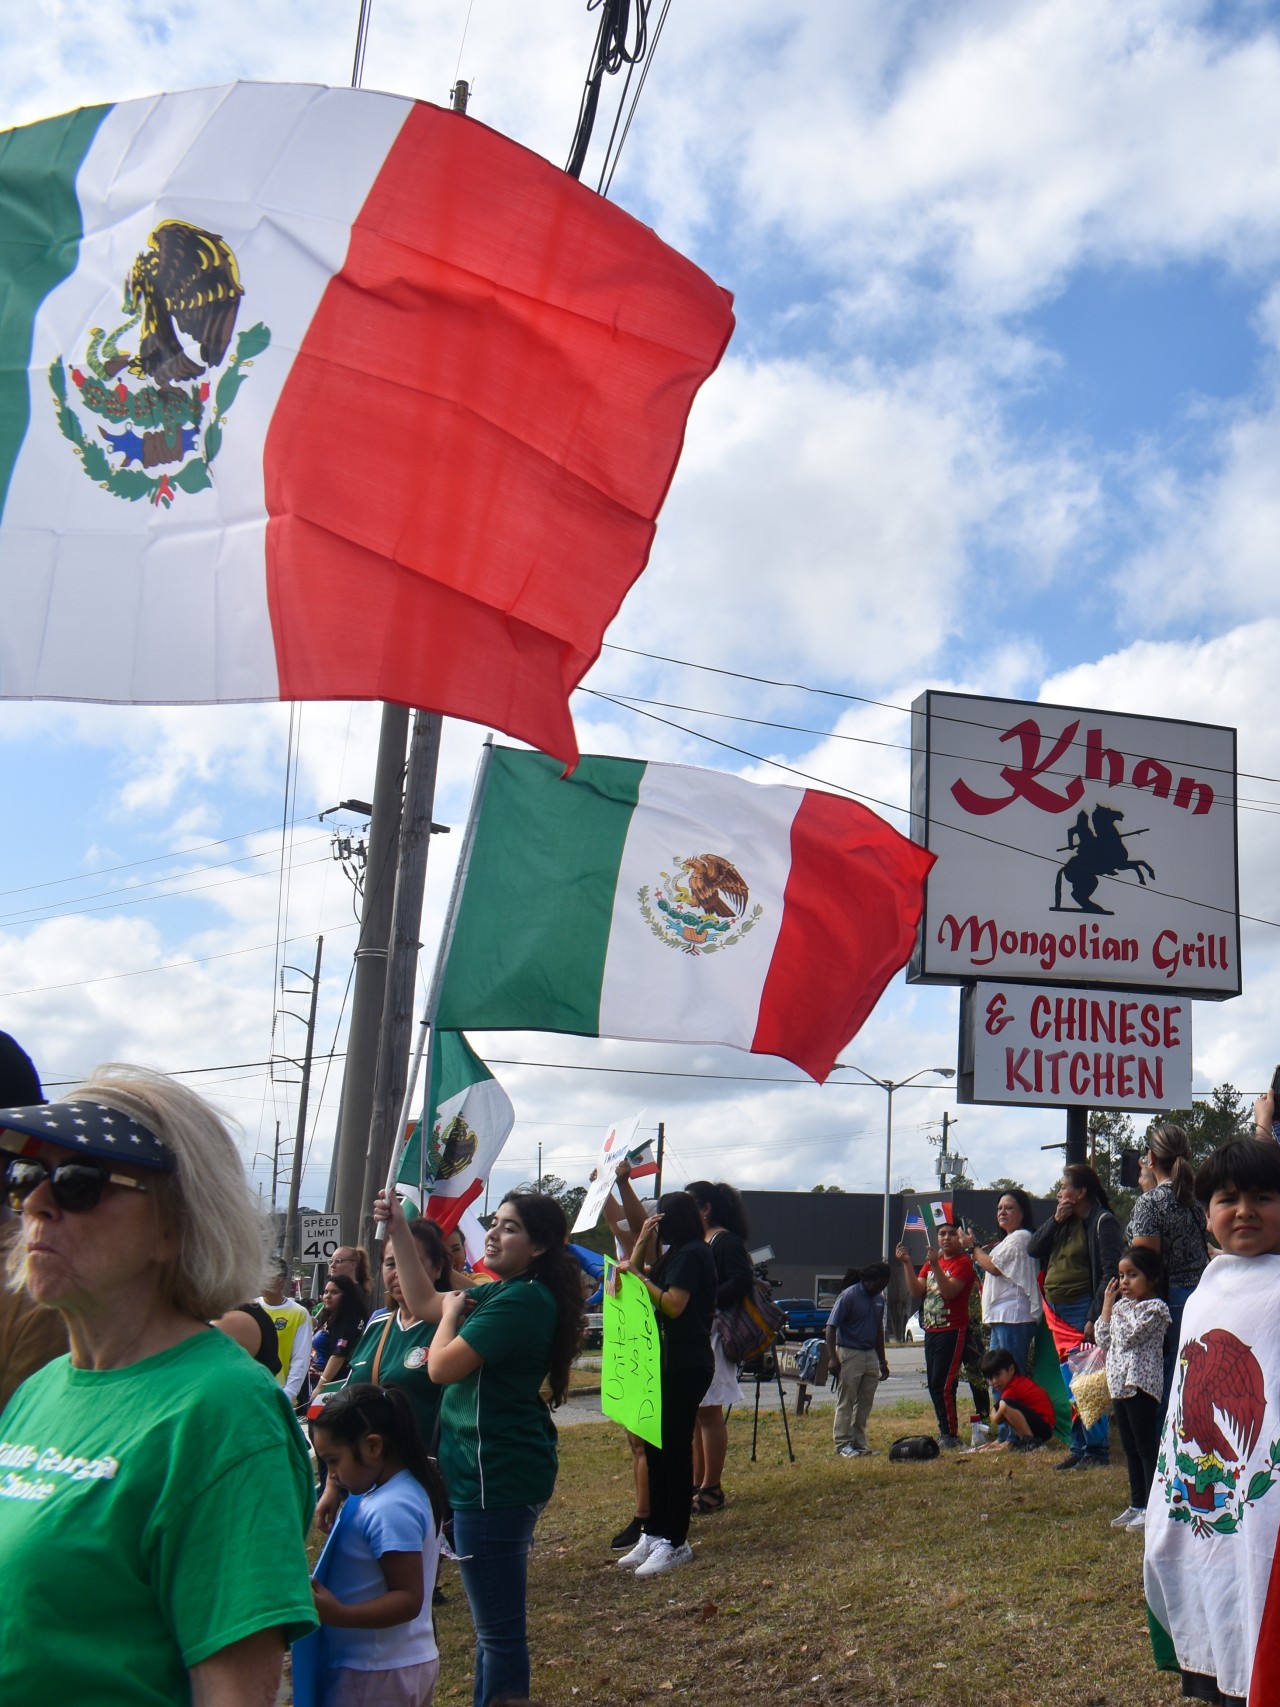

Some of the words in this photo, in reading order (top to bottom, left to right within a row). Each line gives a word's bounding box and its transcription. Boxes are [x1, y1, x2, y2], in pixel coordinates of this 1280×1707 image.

[950, 718, 1214, 815] Khan
[937, 914, 1139, 970] Mongolian
[1152, 929, 1229, 978] Grill
[985, 992, 1015, 1035] &
[1030, 994, 1182, 1048] CHINESE
[1005, 1046, 1164, 1099] KITCHEN
[303, 1218, 339, 1227] SPEED
[307, 1229, 335, 1238] LIMIT
[303, 1240, 338, 1259] 40
[606, 1302, 626, 1400] United
[628, 1334, 640, 1376] Not
